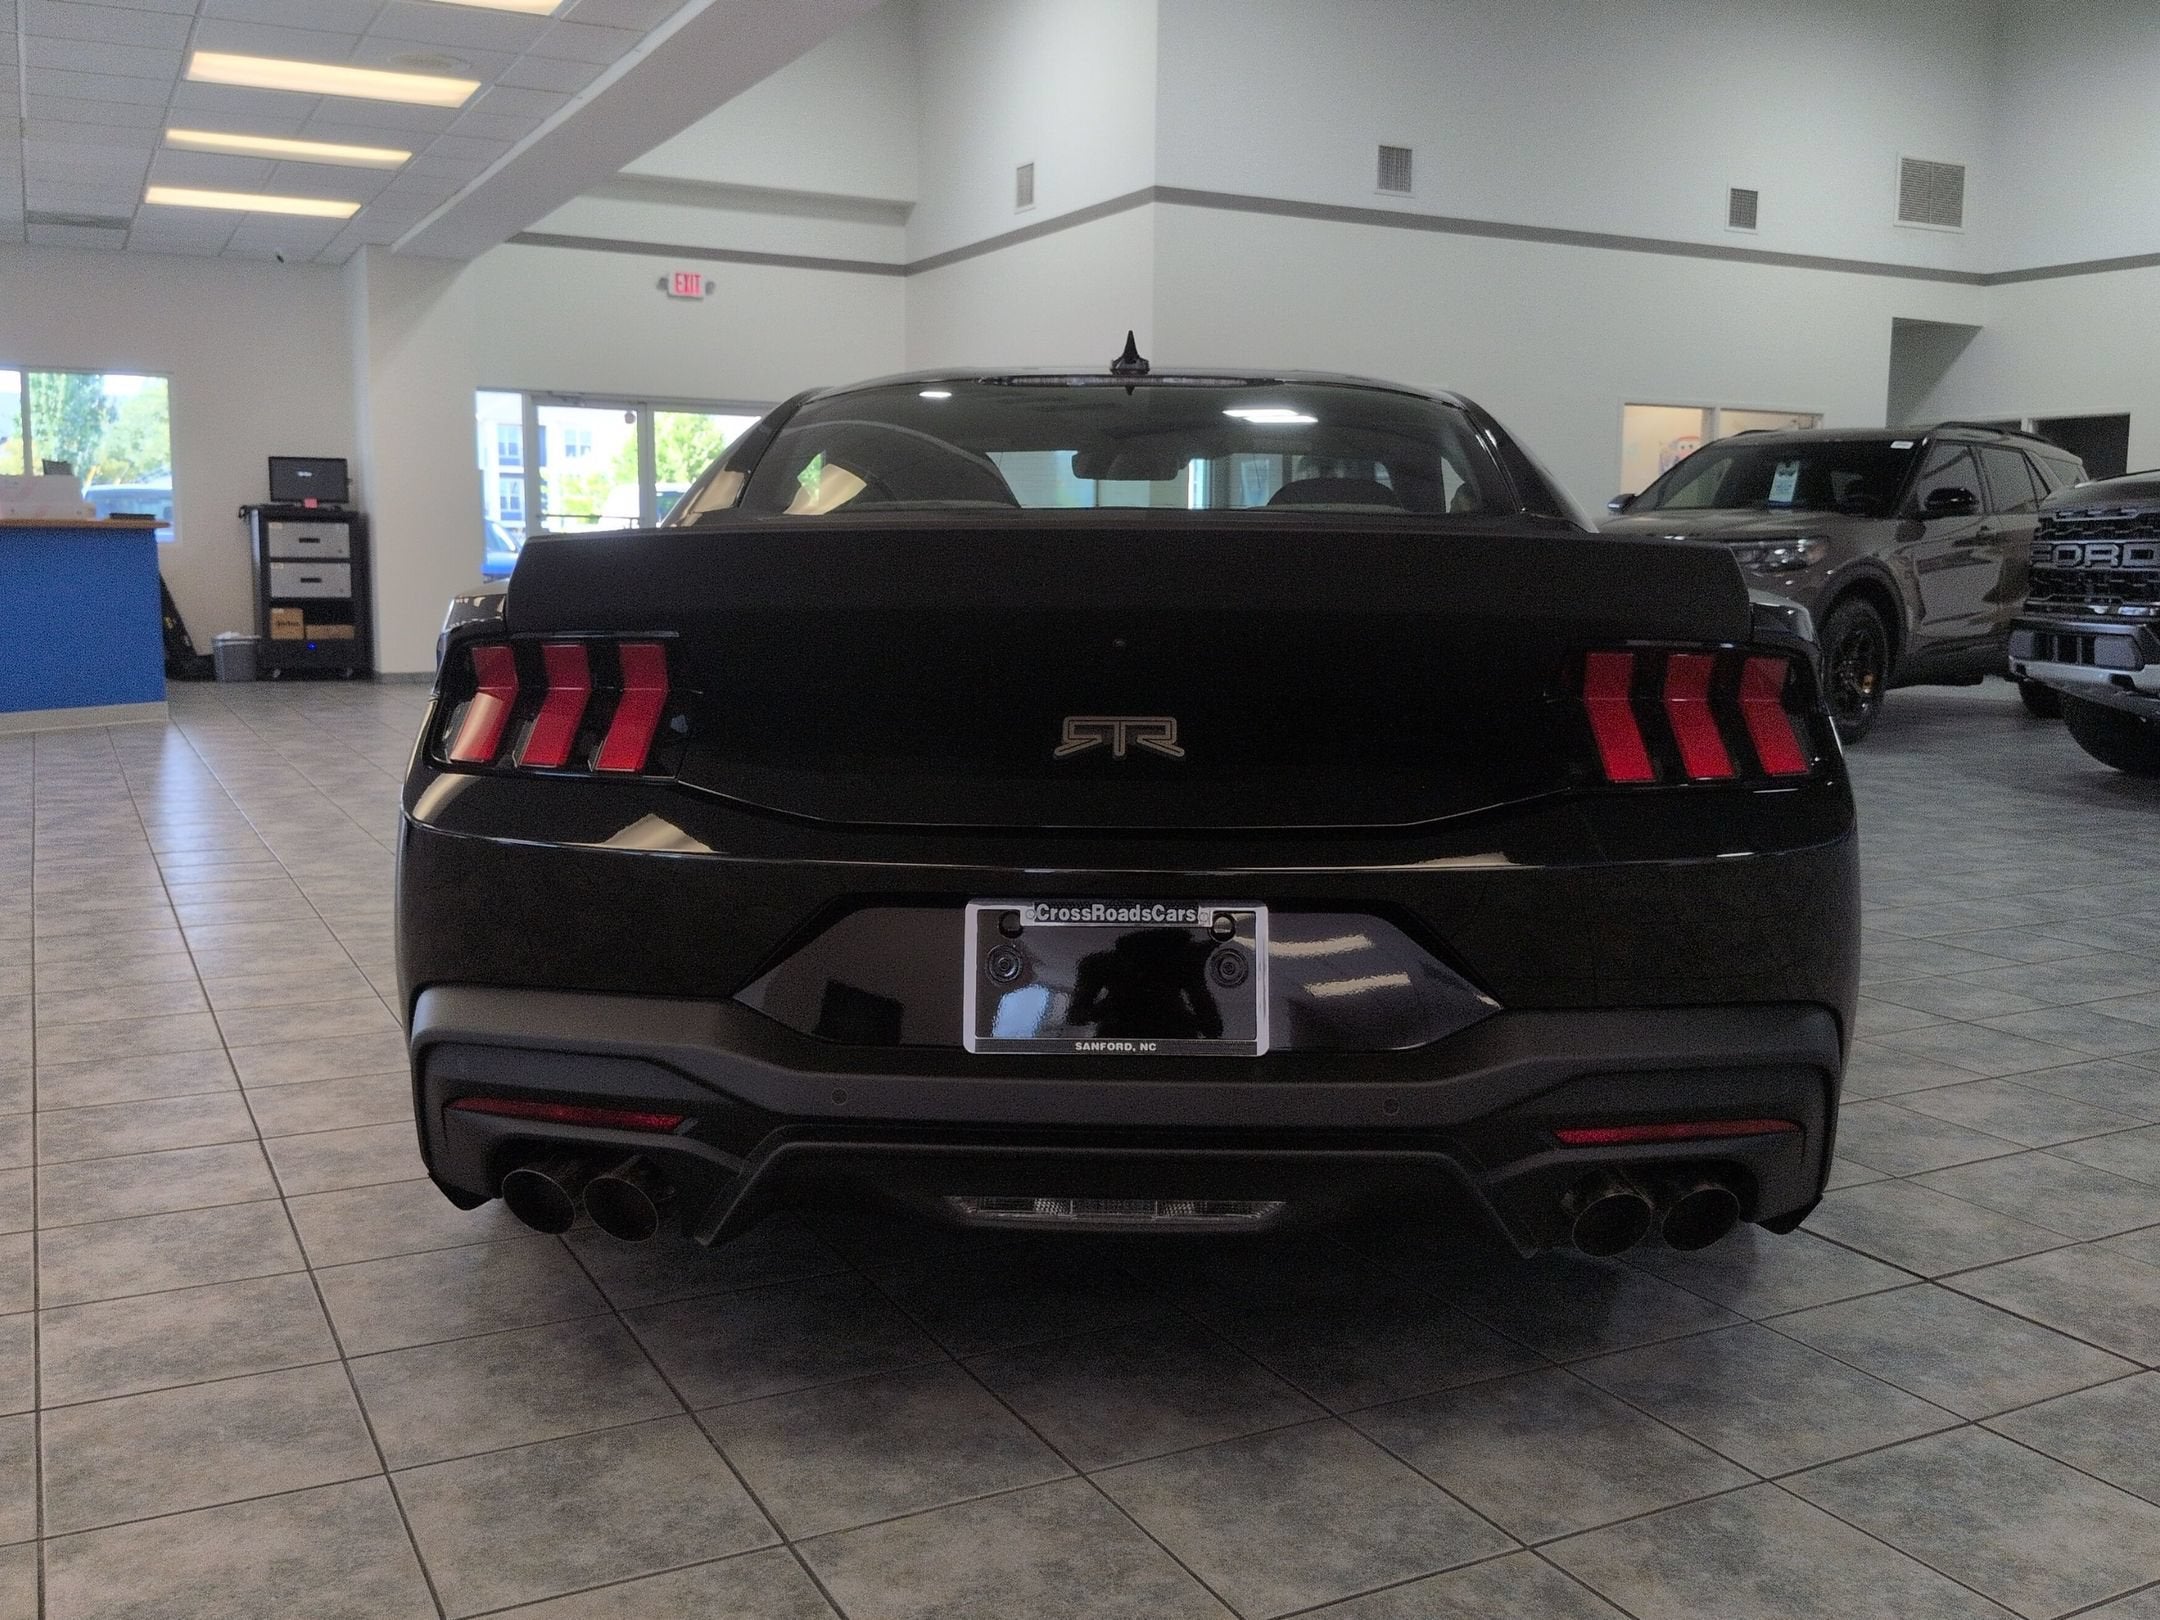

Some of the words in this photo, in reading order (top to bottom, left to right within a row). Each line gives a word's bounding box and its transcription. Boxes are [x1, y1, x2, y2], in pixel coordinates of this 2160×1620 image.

[675, 272, 701, 294] EXIT
[2031, 543, 2160, 568] FORD
[1054, 715, 1185, 758] RTR
[1036, 903, 1197, 924] CrossRoadsCars
[1075, 1041, 1136, 1053] SANFORD,
[1139, 1042, 1157, 1052] NC
